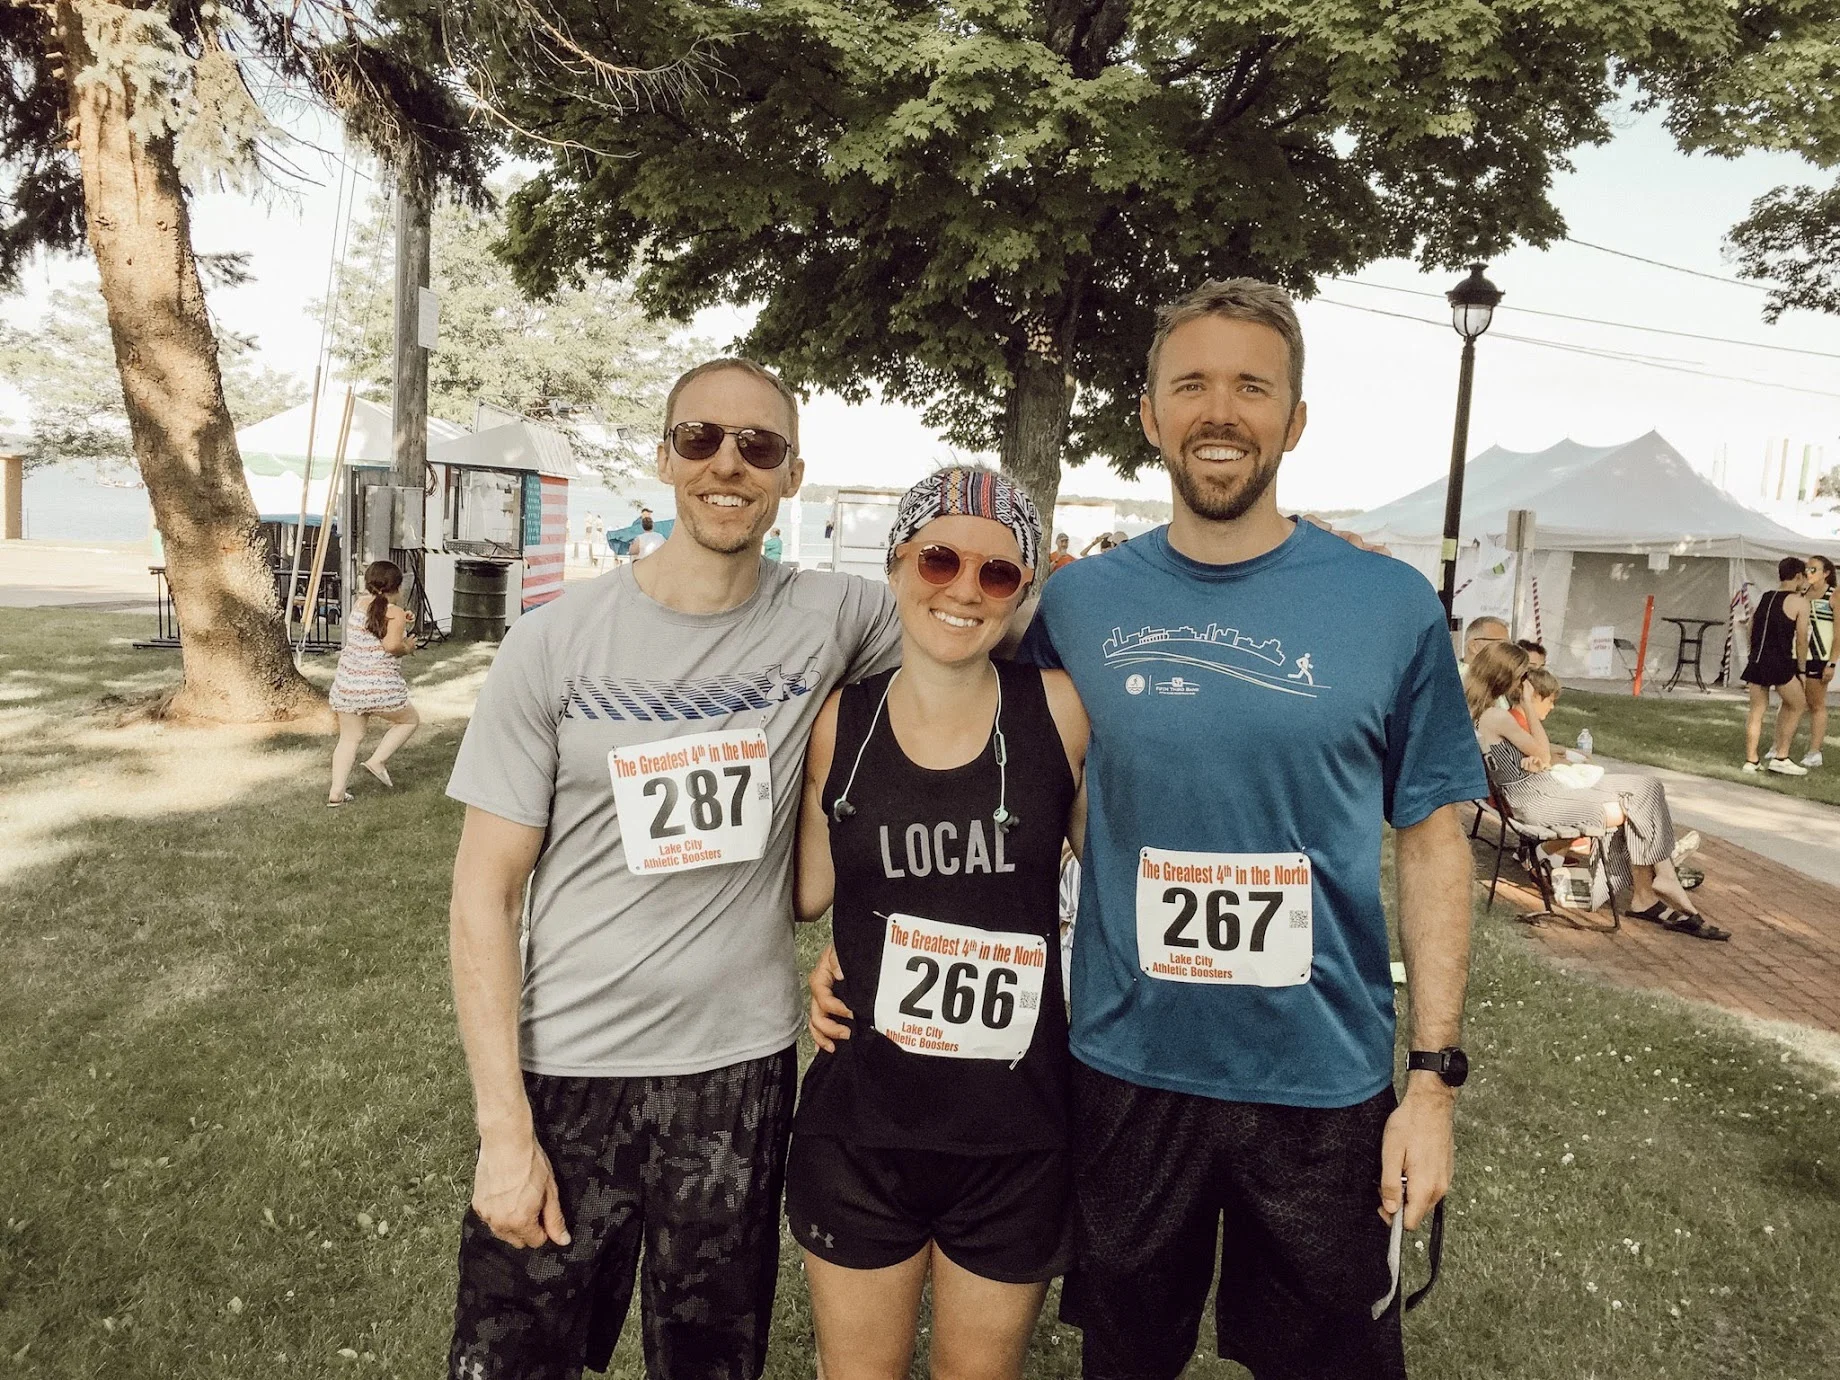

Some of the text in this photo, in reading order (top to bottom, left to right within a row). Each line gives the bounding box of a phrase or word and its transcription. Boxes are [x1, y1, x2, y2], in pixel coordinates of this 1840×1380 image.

[614, 740, 767, 778] The Greatest 4th in the North
[643, 765, 751, 839] 287
[644, 849, 722, 869] Athletic Boosters
[659, 840, 702, 855] Lake City
[879, 819, 1016, 878] LOCAL
[1142, 858, 1308, 885] The Greatest 4th in the North
[1162, 887, 1284, 952] 267
[891, 924, 1044, 968] The Greatest 4th in the North
[1152, 962, 1233, 979] Athletic Boosters
[1170, 953, 1213, 967] Lake City
[899, 956, 1018, 1029] 266
[885, 1029, 959, 1052] Athletic Boosters
[901, 1022, 943, 1039] Lake City
